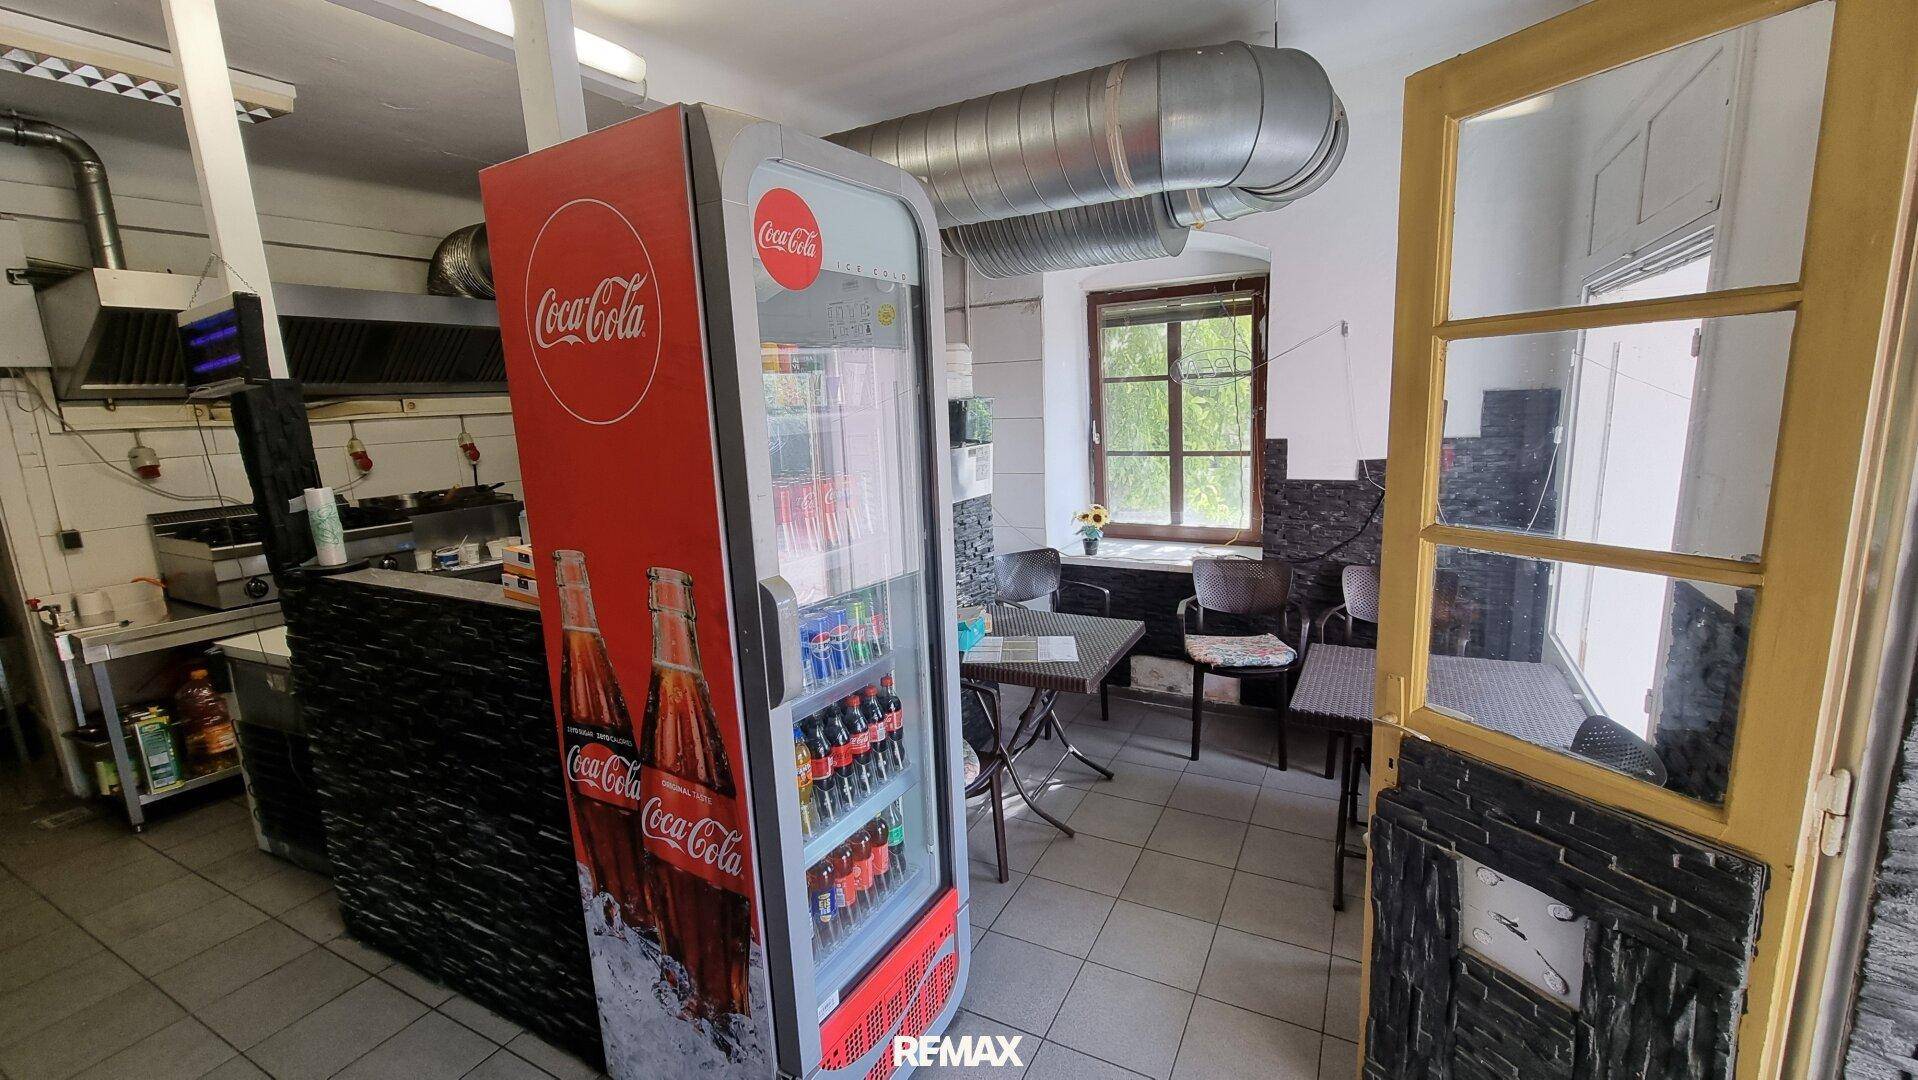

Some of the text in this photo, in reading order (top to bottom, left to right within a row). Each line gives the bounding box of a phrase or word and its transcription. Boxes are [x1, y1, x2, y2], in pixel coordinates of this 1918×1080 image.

[759, 220, 818, 258] Coca-Cola
[837, 261, 907, 281] ICE COLD
[535, 271, 648, 349] Coca-Cola
[567, 744, 642, 801] Coca-Cola
[661, 778, 713, 806] ORIGINAL TASTE
[641, 796, 743, 877] Coca-Cola
